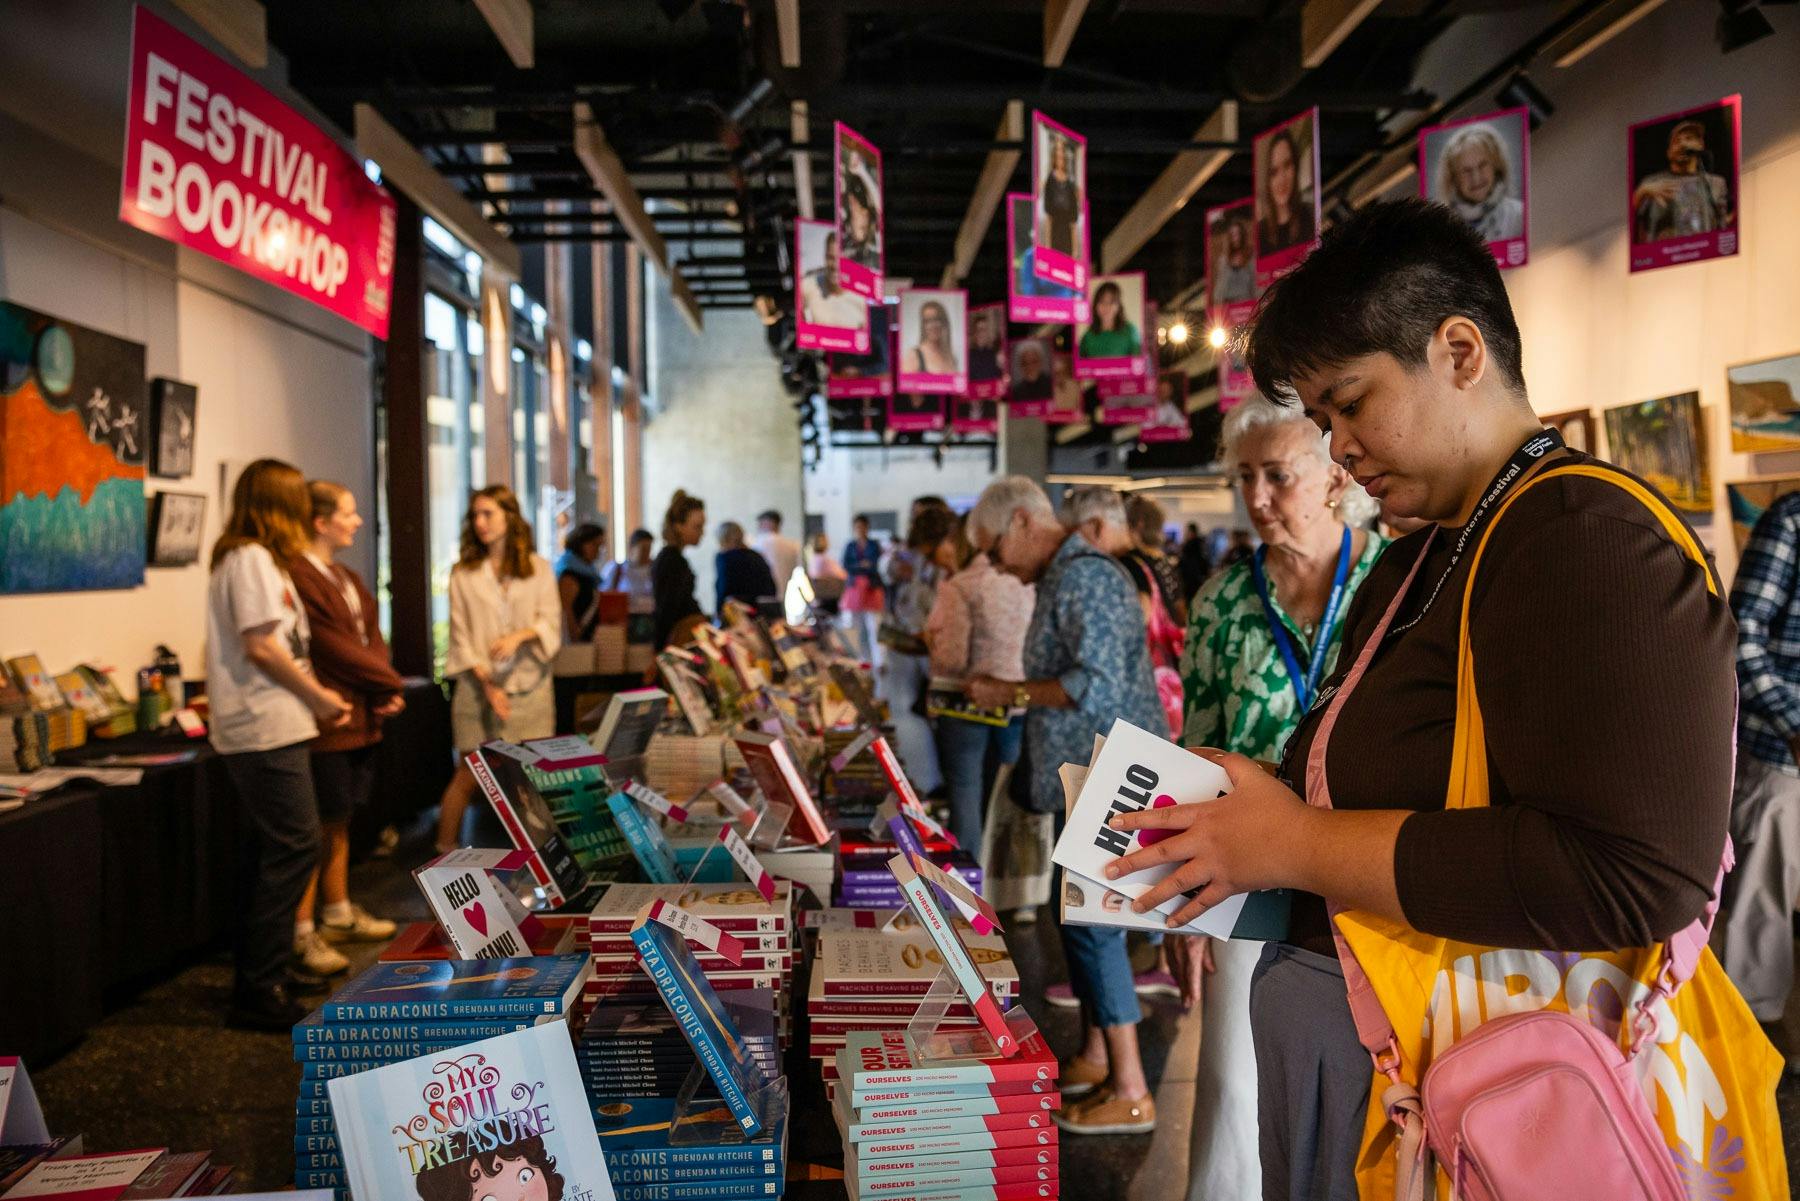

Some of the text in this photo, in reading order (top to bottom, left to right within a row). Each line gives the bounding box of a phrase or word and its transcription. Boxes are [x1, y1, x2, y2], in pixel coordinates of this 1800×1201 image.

[143, 51, 332, 226] FESTIVAL
[136, 139, 349, 298] BOOKSHOP
[1451, 555, 1459, 565] &
[1456, 509, 1484, 553] Writers
[1481, 463, 1521, 508] Festival
[474, 762, 496, 797] FAKING
[443, 872, 480, 911] HELLO
[915, 890, 941, 930] OURSELVES
[337, 1003, 535, 1020] ETA DRACONIS BRENDAN RITCHIE
[307, 1025, 506, 1042] ETA DRACONIS BRENDAN RITCHIE
[638, 940, 660, 968] ETA
[655, 967, 702, 1039] DRACONIS
[698, 1040, 724, 1078] BRENDAN
[719, 1078, 744, 1111] RITCHIE
[309, 1046, 336, 1060] ETA
[342, 1044, 421, 1059] DRACONIS
[860, 1047, 886, 1070] OUR
[317, 1064, 345, 1078] ETA
[440, 1058, 480, 1093] MY
[866, 1076, 912, 1084] OURSELVES
[864, 1093, 910, 1101] OURSELVES
[312, 1100, 330, 1114] ET
[425, 1078, 510, 1134] SOUL
[872, 1109, 918, 1118] OURSELVES
[396, 1097, 556, 1176] TREASURE
[860, 1128, 906, 1136] OURSELVES
[308, 1136, 336, 1151] ETA
[870, 1144, 915, 1152] OURSELVES
[312, 1154, 339, 1167] ETA
[609, 1151, 753, 1166] ACONIS BRENDAN RITCHIE
[612, 1166, 755, 1182] ACONIS BRENDAN RITCHIE
[869, 1163, 914, 1171] OURSELVES
[309, 1173, 337, 1186] ETA
[870, 1181, 916, 1190] OURSELVES
[572, 1183, 582, 1193] BY
[615, 1185, 755, 1201] CONIS BRENDAN RITCHIE
